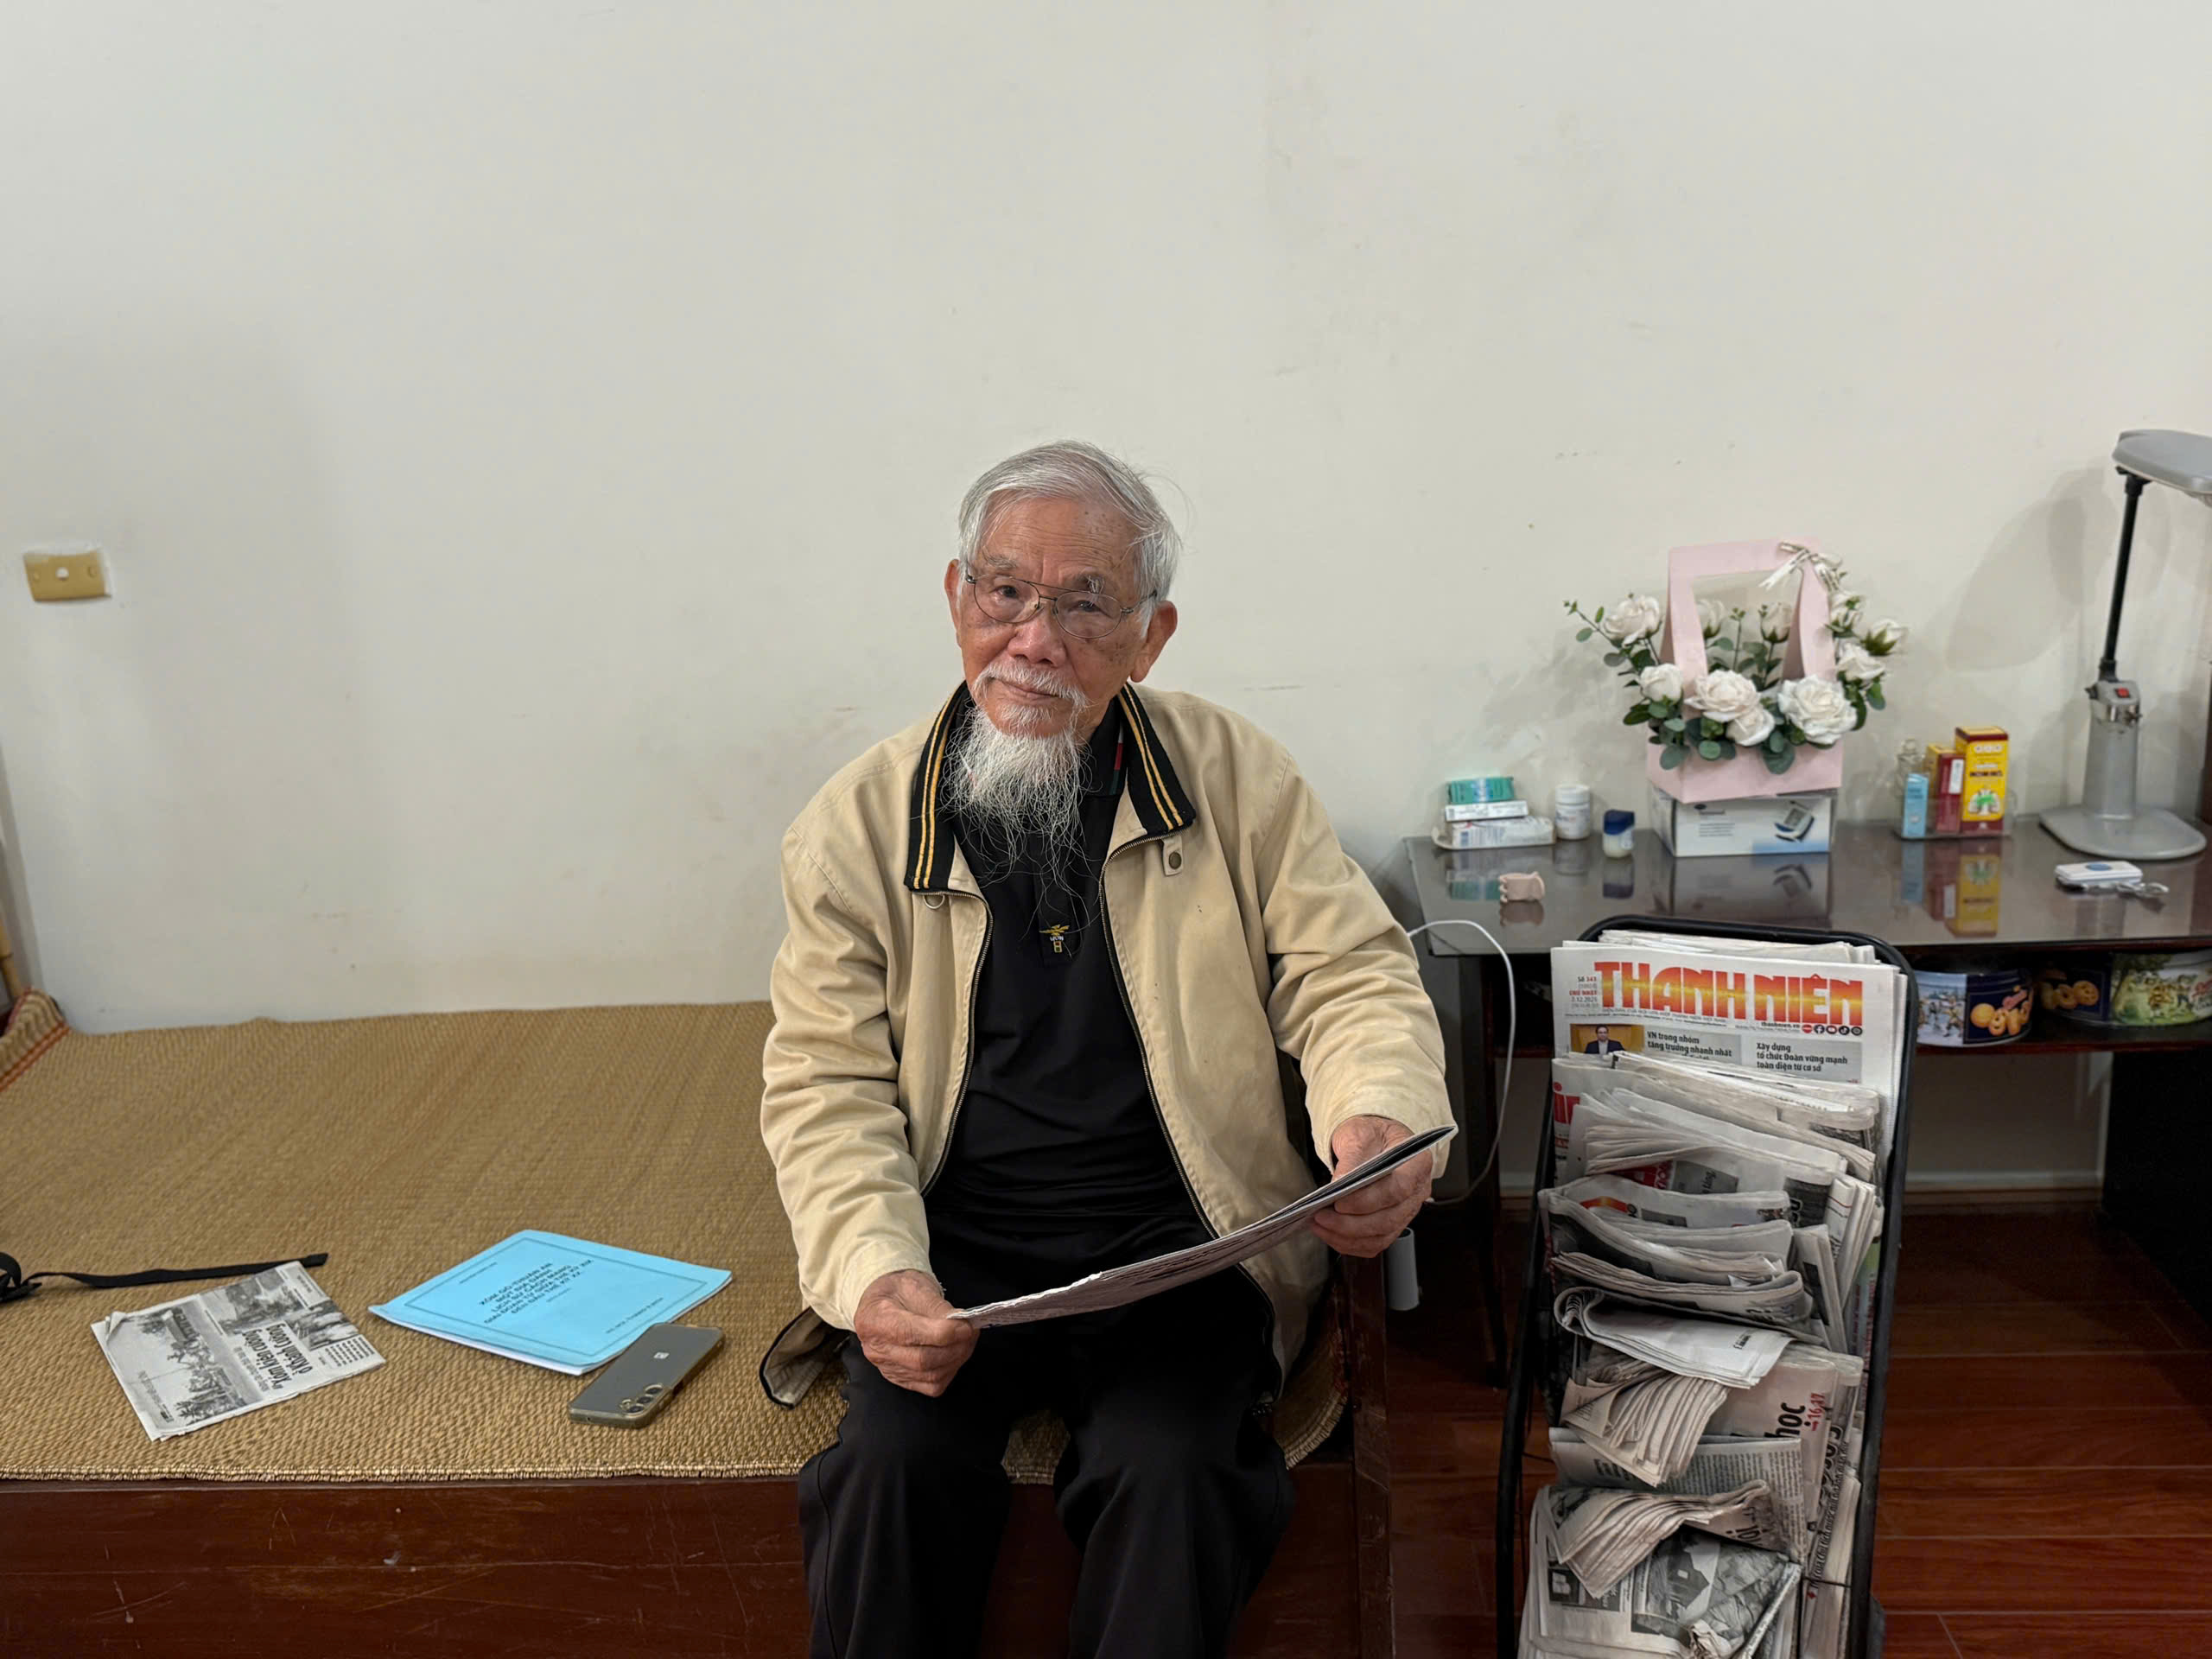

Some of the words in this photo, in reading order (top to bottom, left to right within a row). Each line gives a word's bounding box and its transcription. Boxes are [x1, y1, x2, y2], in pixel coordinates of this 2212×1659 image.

[1594, 961, 1746, 1020] THANH
[1754, 974, 1863, 1026] NIÊN
[1647, 1031, 1657, 1039] VN
[1658, 1033, 1677, 1043] trong
[1690, 1046, 1713, 1056] nhanh
[1757, 1042, 1770, 1052] Xây
[1764, 1402, 1811, 1439] học
